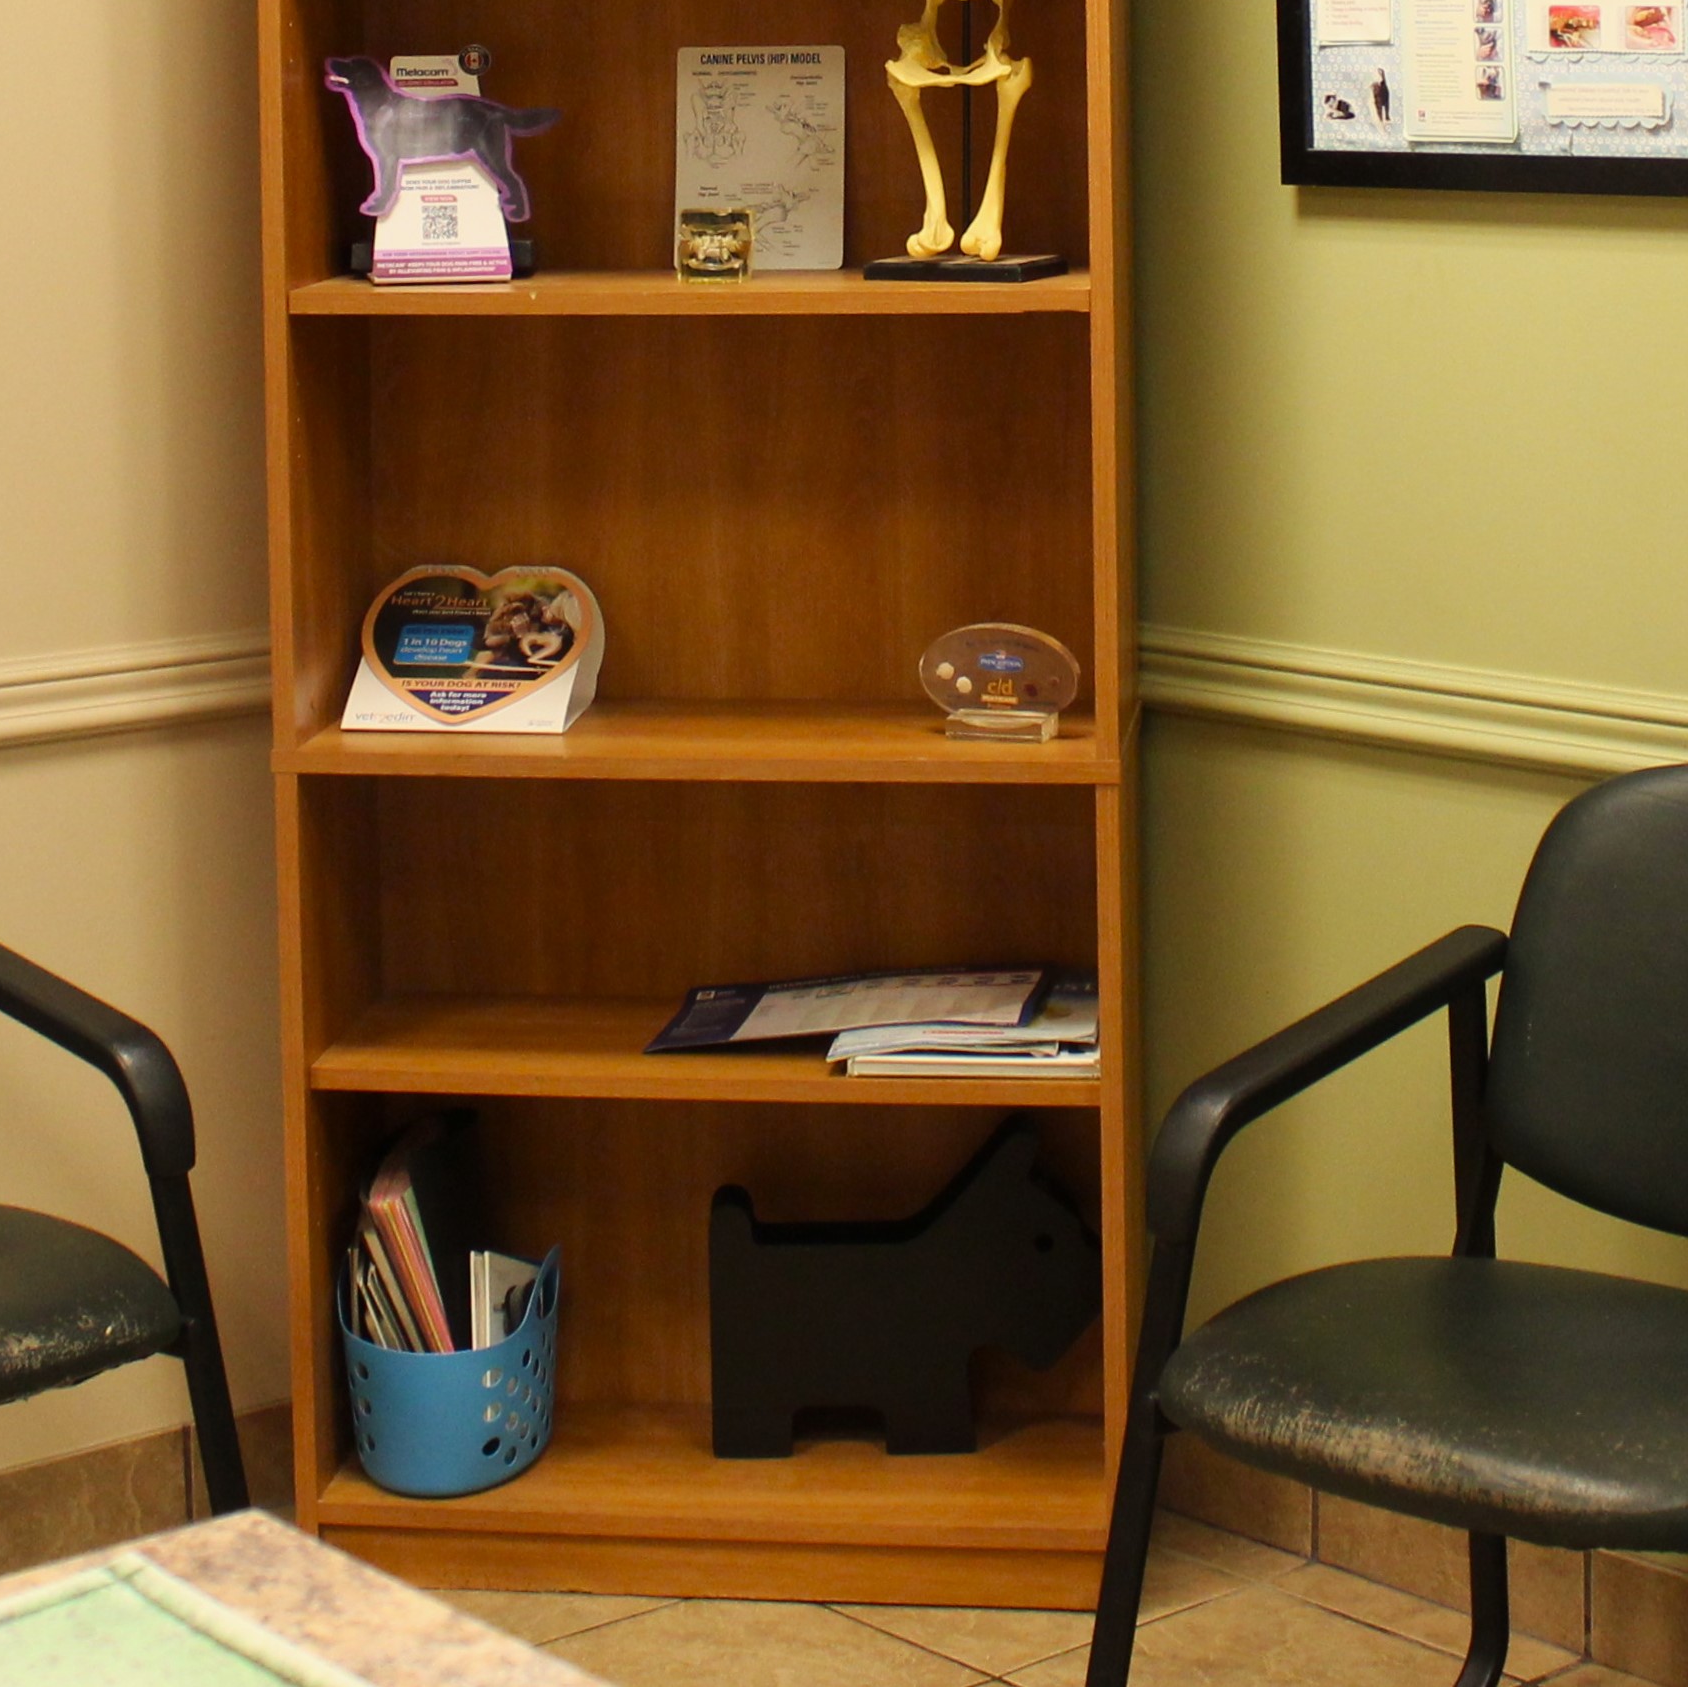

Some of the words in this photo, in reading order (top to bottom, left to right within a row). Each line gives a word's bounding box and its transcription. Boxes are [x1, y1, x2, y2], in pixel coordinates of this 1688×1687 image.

[700, 53, 734, 65] CANINE
[736, 53, 766, 65] PELVIS
[767, 53, 789, 65] (HIP)
[790, 53, 822, 64] MODEL
[396, 68, 449, 77] Metacam
[411, 638, 422, 646] in
[425, 638, 438, 646] 10
[439, 638, 468, 648] Dogs
[400, 646, 438, 654] develop
[439, 646, 463, 654] heart
[414, 680, 445, 688] YOUR
[987, 679, 1014, 696] c/d
[430, 691, 447, 699] Ask
[448, 691, 460, 699] for
[429, 697, 484, 705] information
[440, 704, 470, 712] today!
